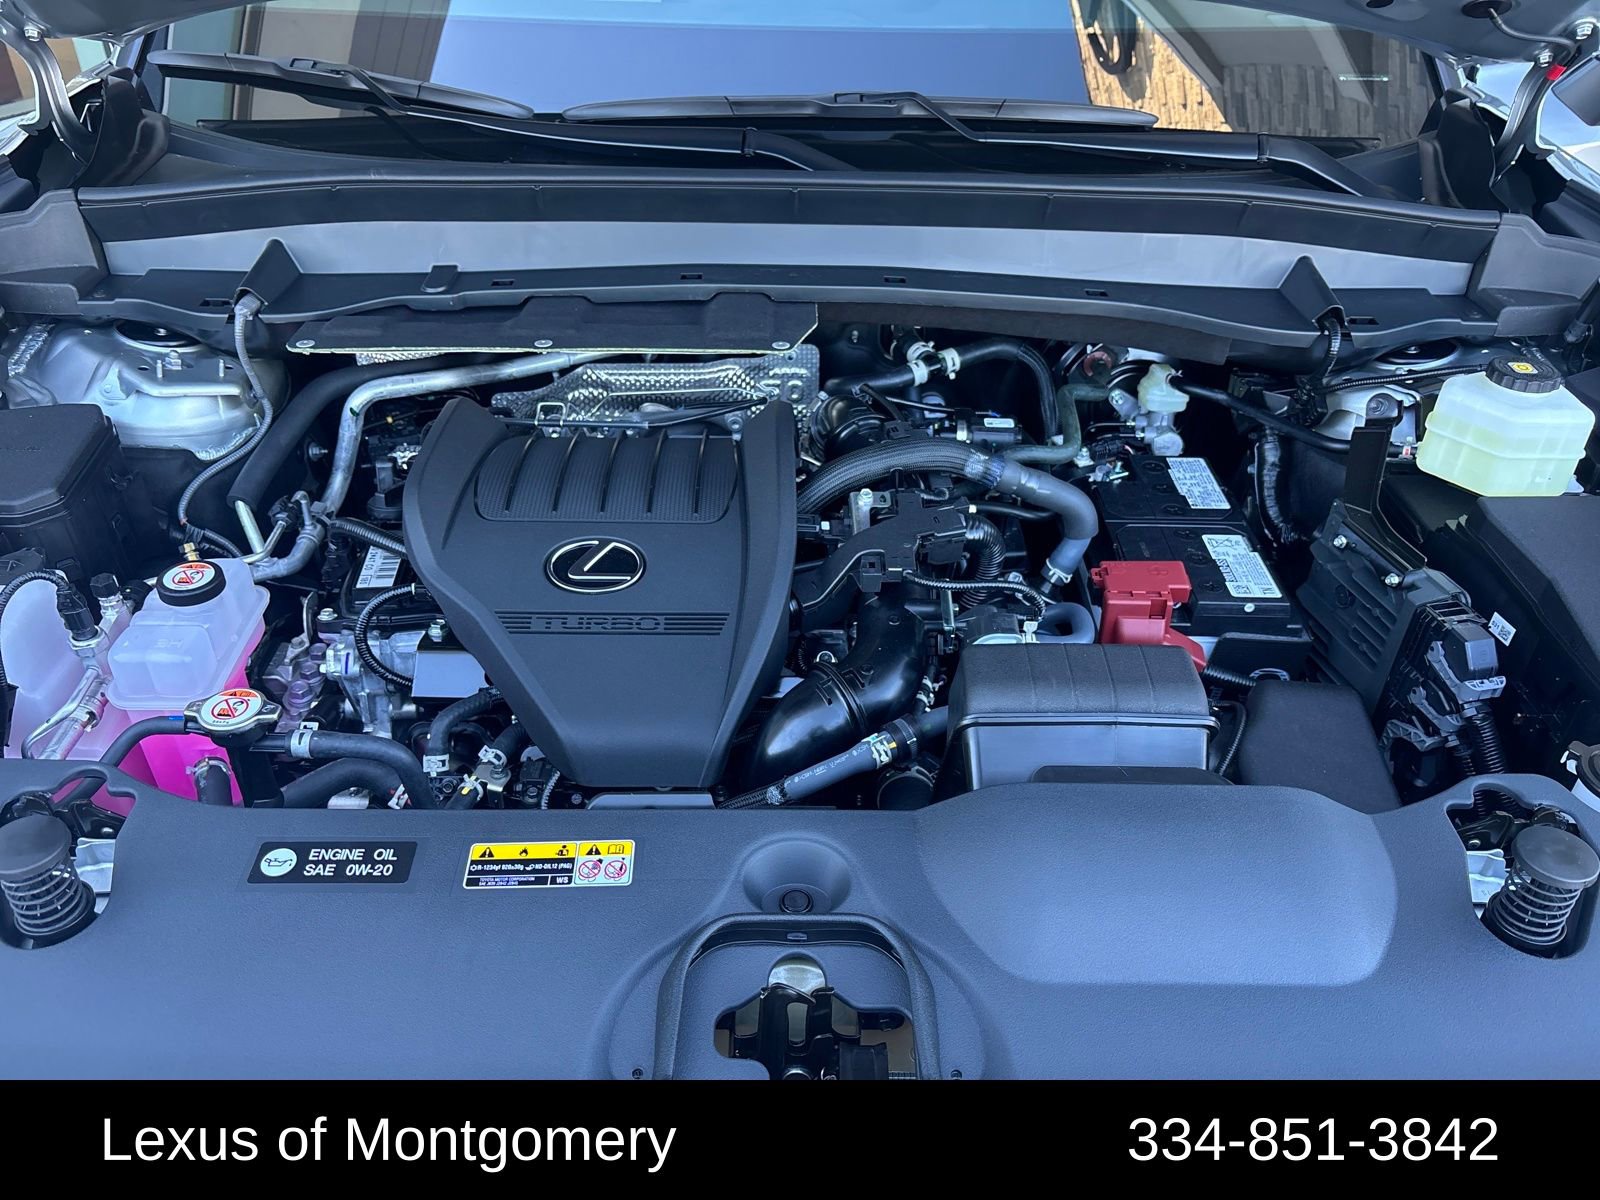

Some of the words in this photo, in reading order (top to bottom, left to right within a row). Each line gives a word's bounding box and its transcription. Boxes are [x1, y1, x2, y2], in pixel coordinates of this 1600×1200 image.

[535, 616, 661, 631] TURBO
[308, 848, 365, 861] ENGINE
[373, 848, 398, 861] OIL
[303, 864, 336, 876] SAE
[345, 864, 393, 876] 0W-20
[556, 876, 569, 884] WS
